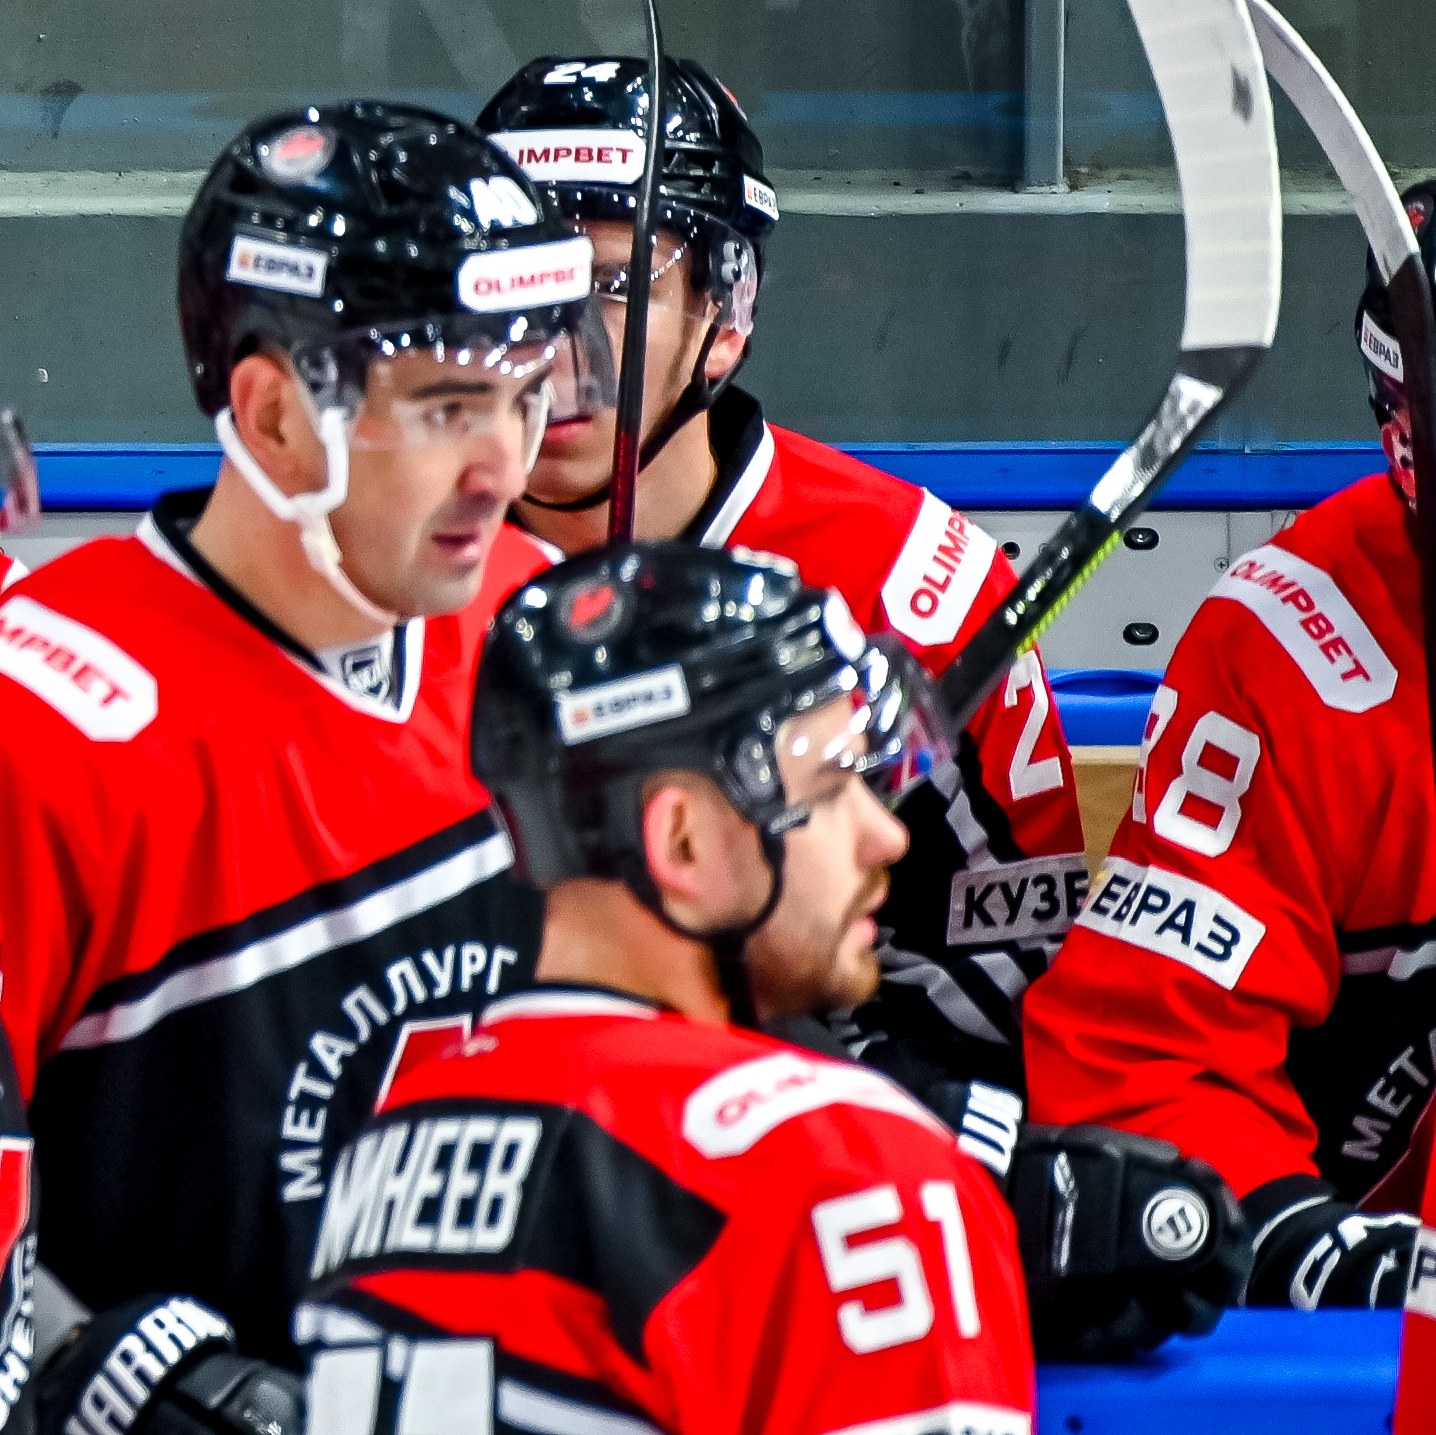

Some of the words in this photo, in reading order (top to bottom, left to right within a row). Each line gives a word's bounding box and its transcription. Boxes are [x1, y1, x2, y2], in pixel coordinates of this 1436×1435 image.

[909, 510, 970, 619] OLIMP
[1090, 872, 1241, 964] ЕВРАЗ
[279, 941, 519, 1205] МЕТАЛЛУРГ
[812, 1179, 982, 1355] 51
